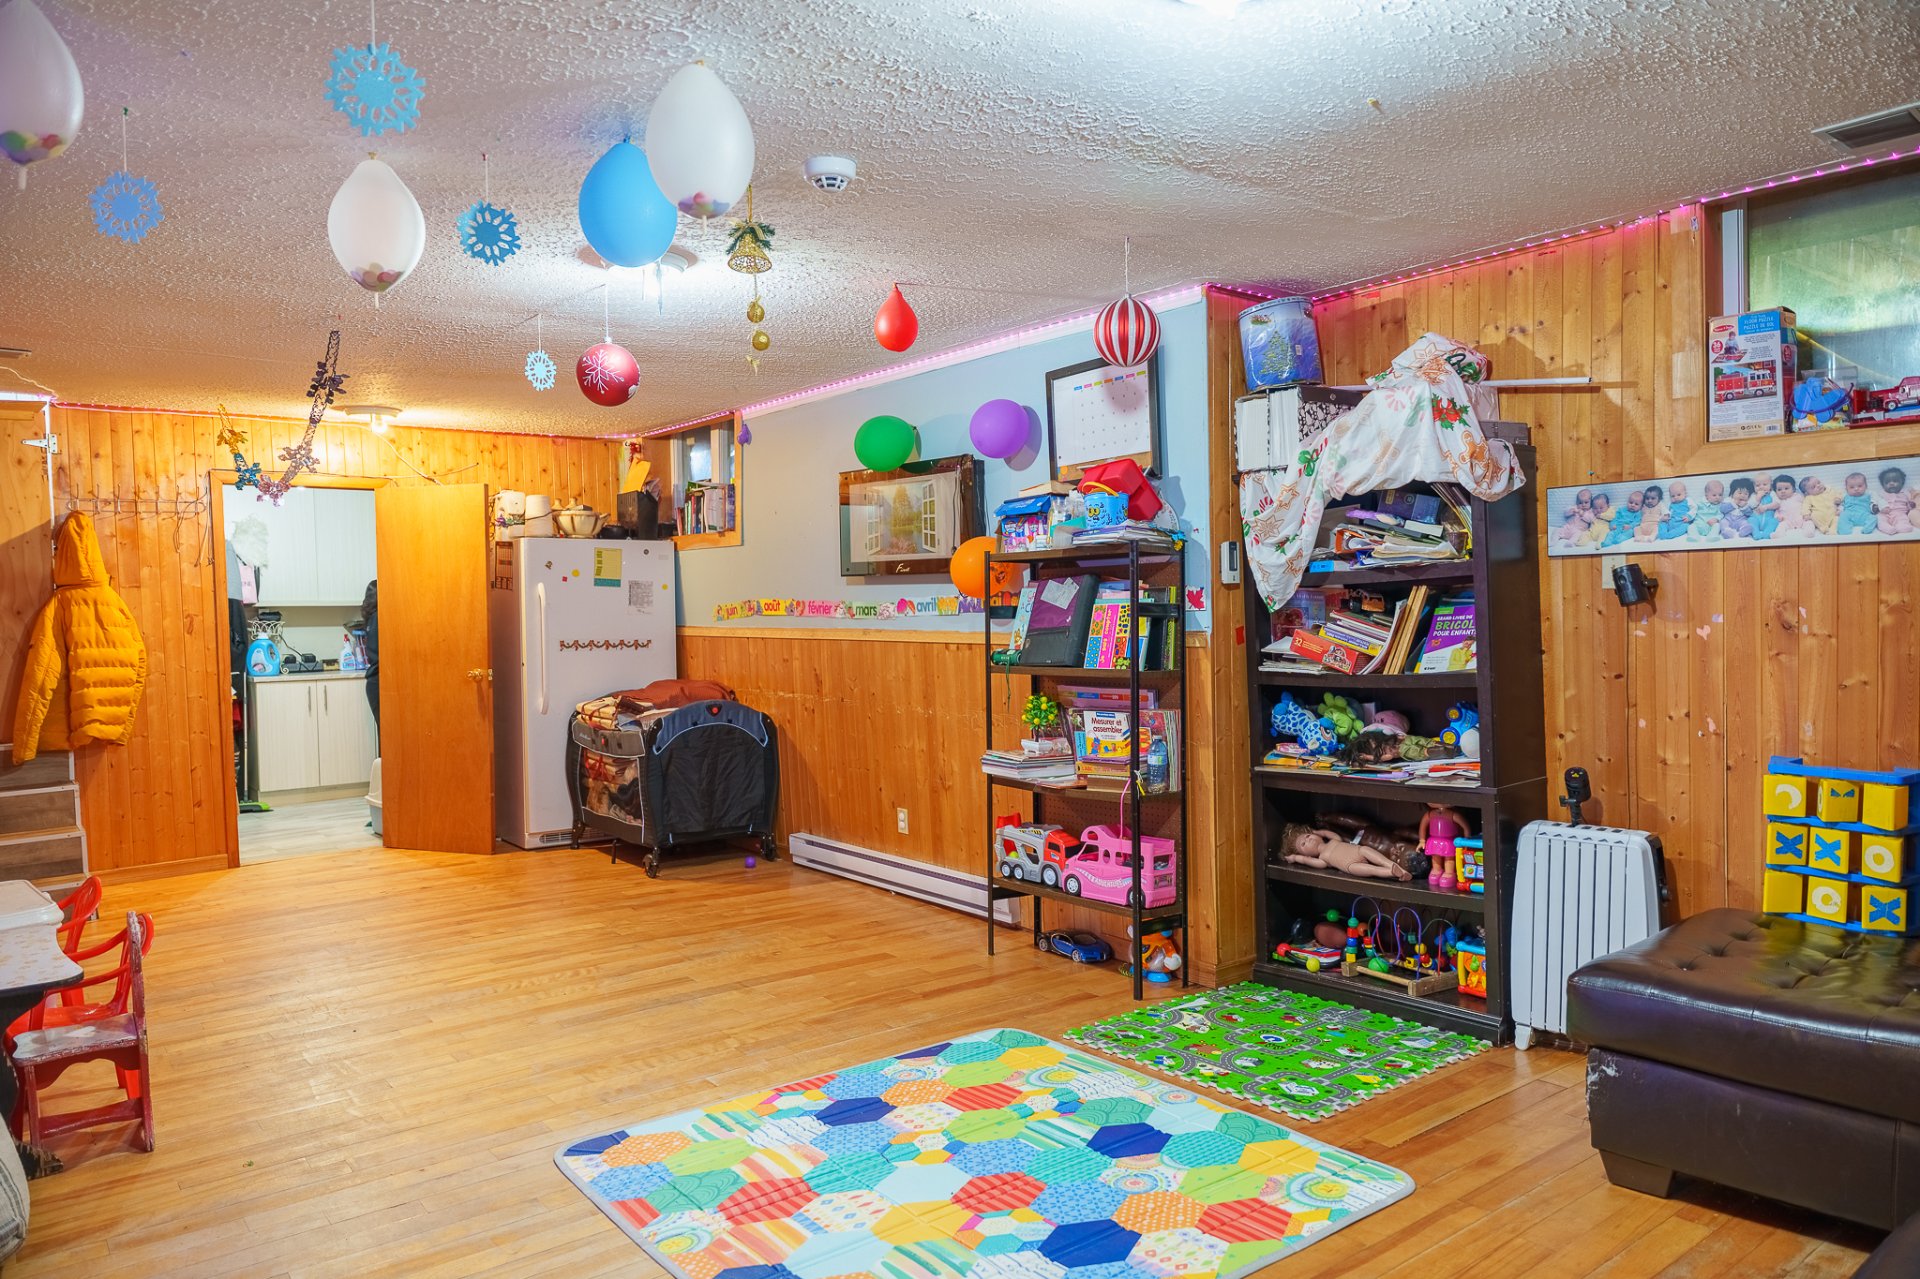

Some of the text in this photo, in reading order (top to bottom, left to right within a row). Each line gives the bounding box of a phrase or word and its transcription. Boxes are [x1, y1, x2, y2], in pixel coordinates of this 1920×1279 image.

[763, 599, 780, 611] août
[808, 601, 832, 615] février
[916, 597, 936, 612] avril
[855, 605, 877, 616] mars
[1435, 620, 1475, 630] BRICOL
[1091, 717, 1115, 725] Mesurer
[1093, 726, 1123, 734] assembler
